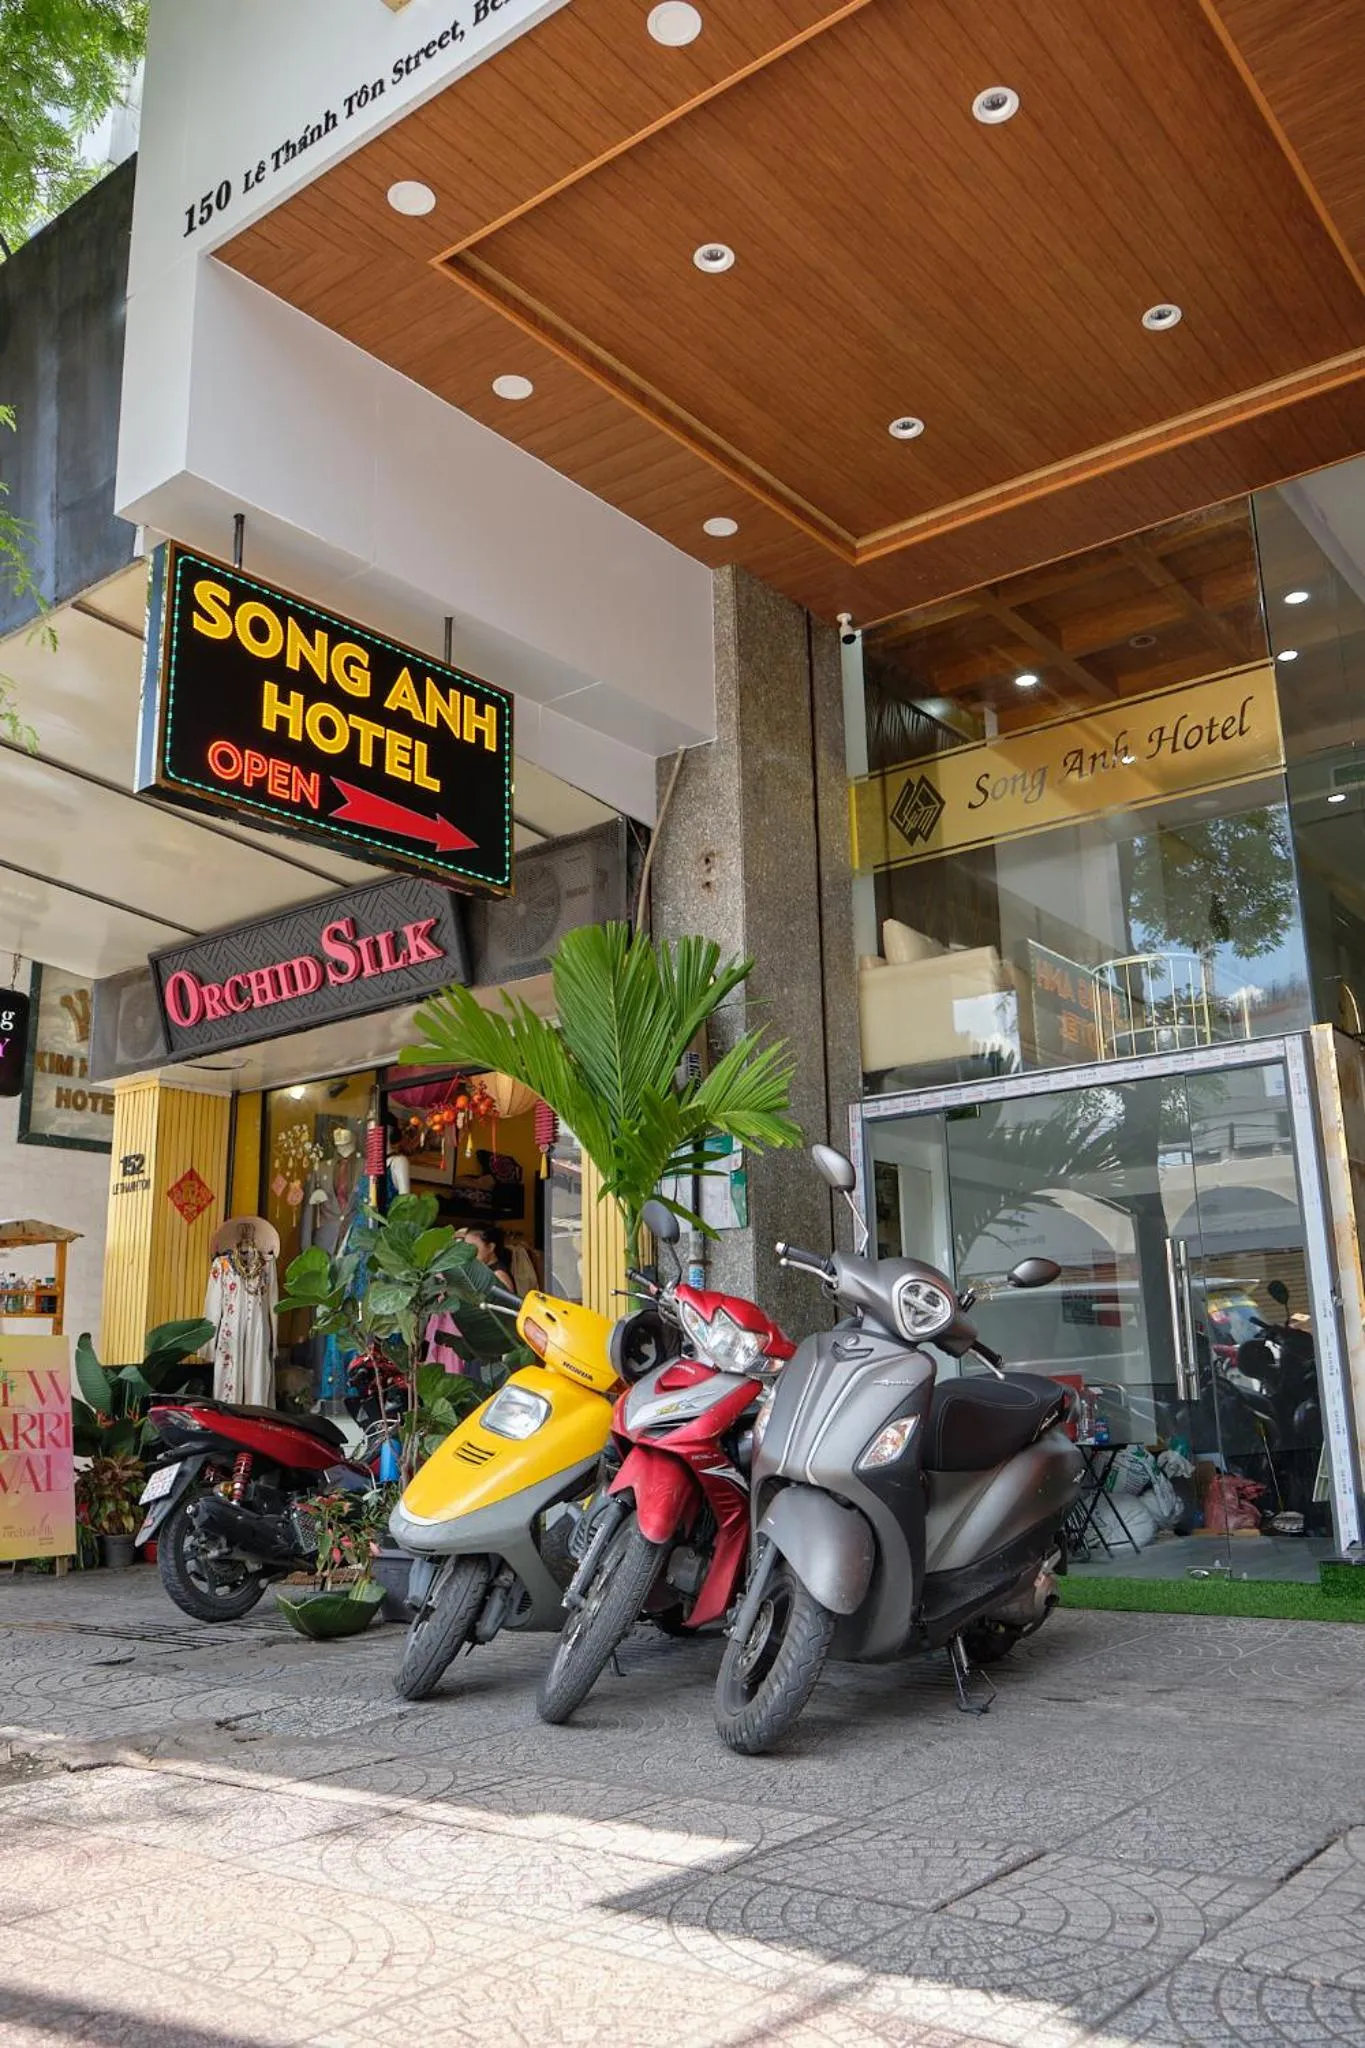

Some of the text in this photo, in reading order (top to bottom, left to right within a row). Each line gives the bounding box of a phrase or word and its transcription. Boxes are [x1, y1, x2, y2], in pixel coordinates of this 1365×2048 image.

[183, 180, 232, 238] 150
[242, 160, 266, 194] Lê
[270, 109, 339, 173] Thánh
[343, 78, 386, 119] Tôn
[391, 19, 465, 85] Street,
[193, 580, 497, 752] SONG ANH
[207, 740, 321, 810] OPEN
[262, 681, 441, 792] HOTEL
[967, 696, 1254, 810] Song Anh Hotel
[164, 917, 448, 1028] ORCHID SILK
[34, 1051, 75, 1077] KIM
